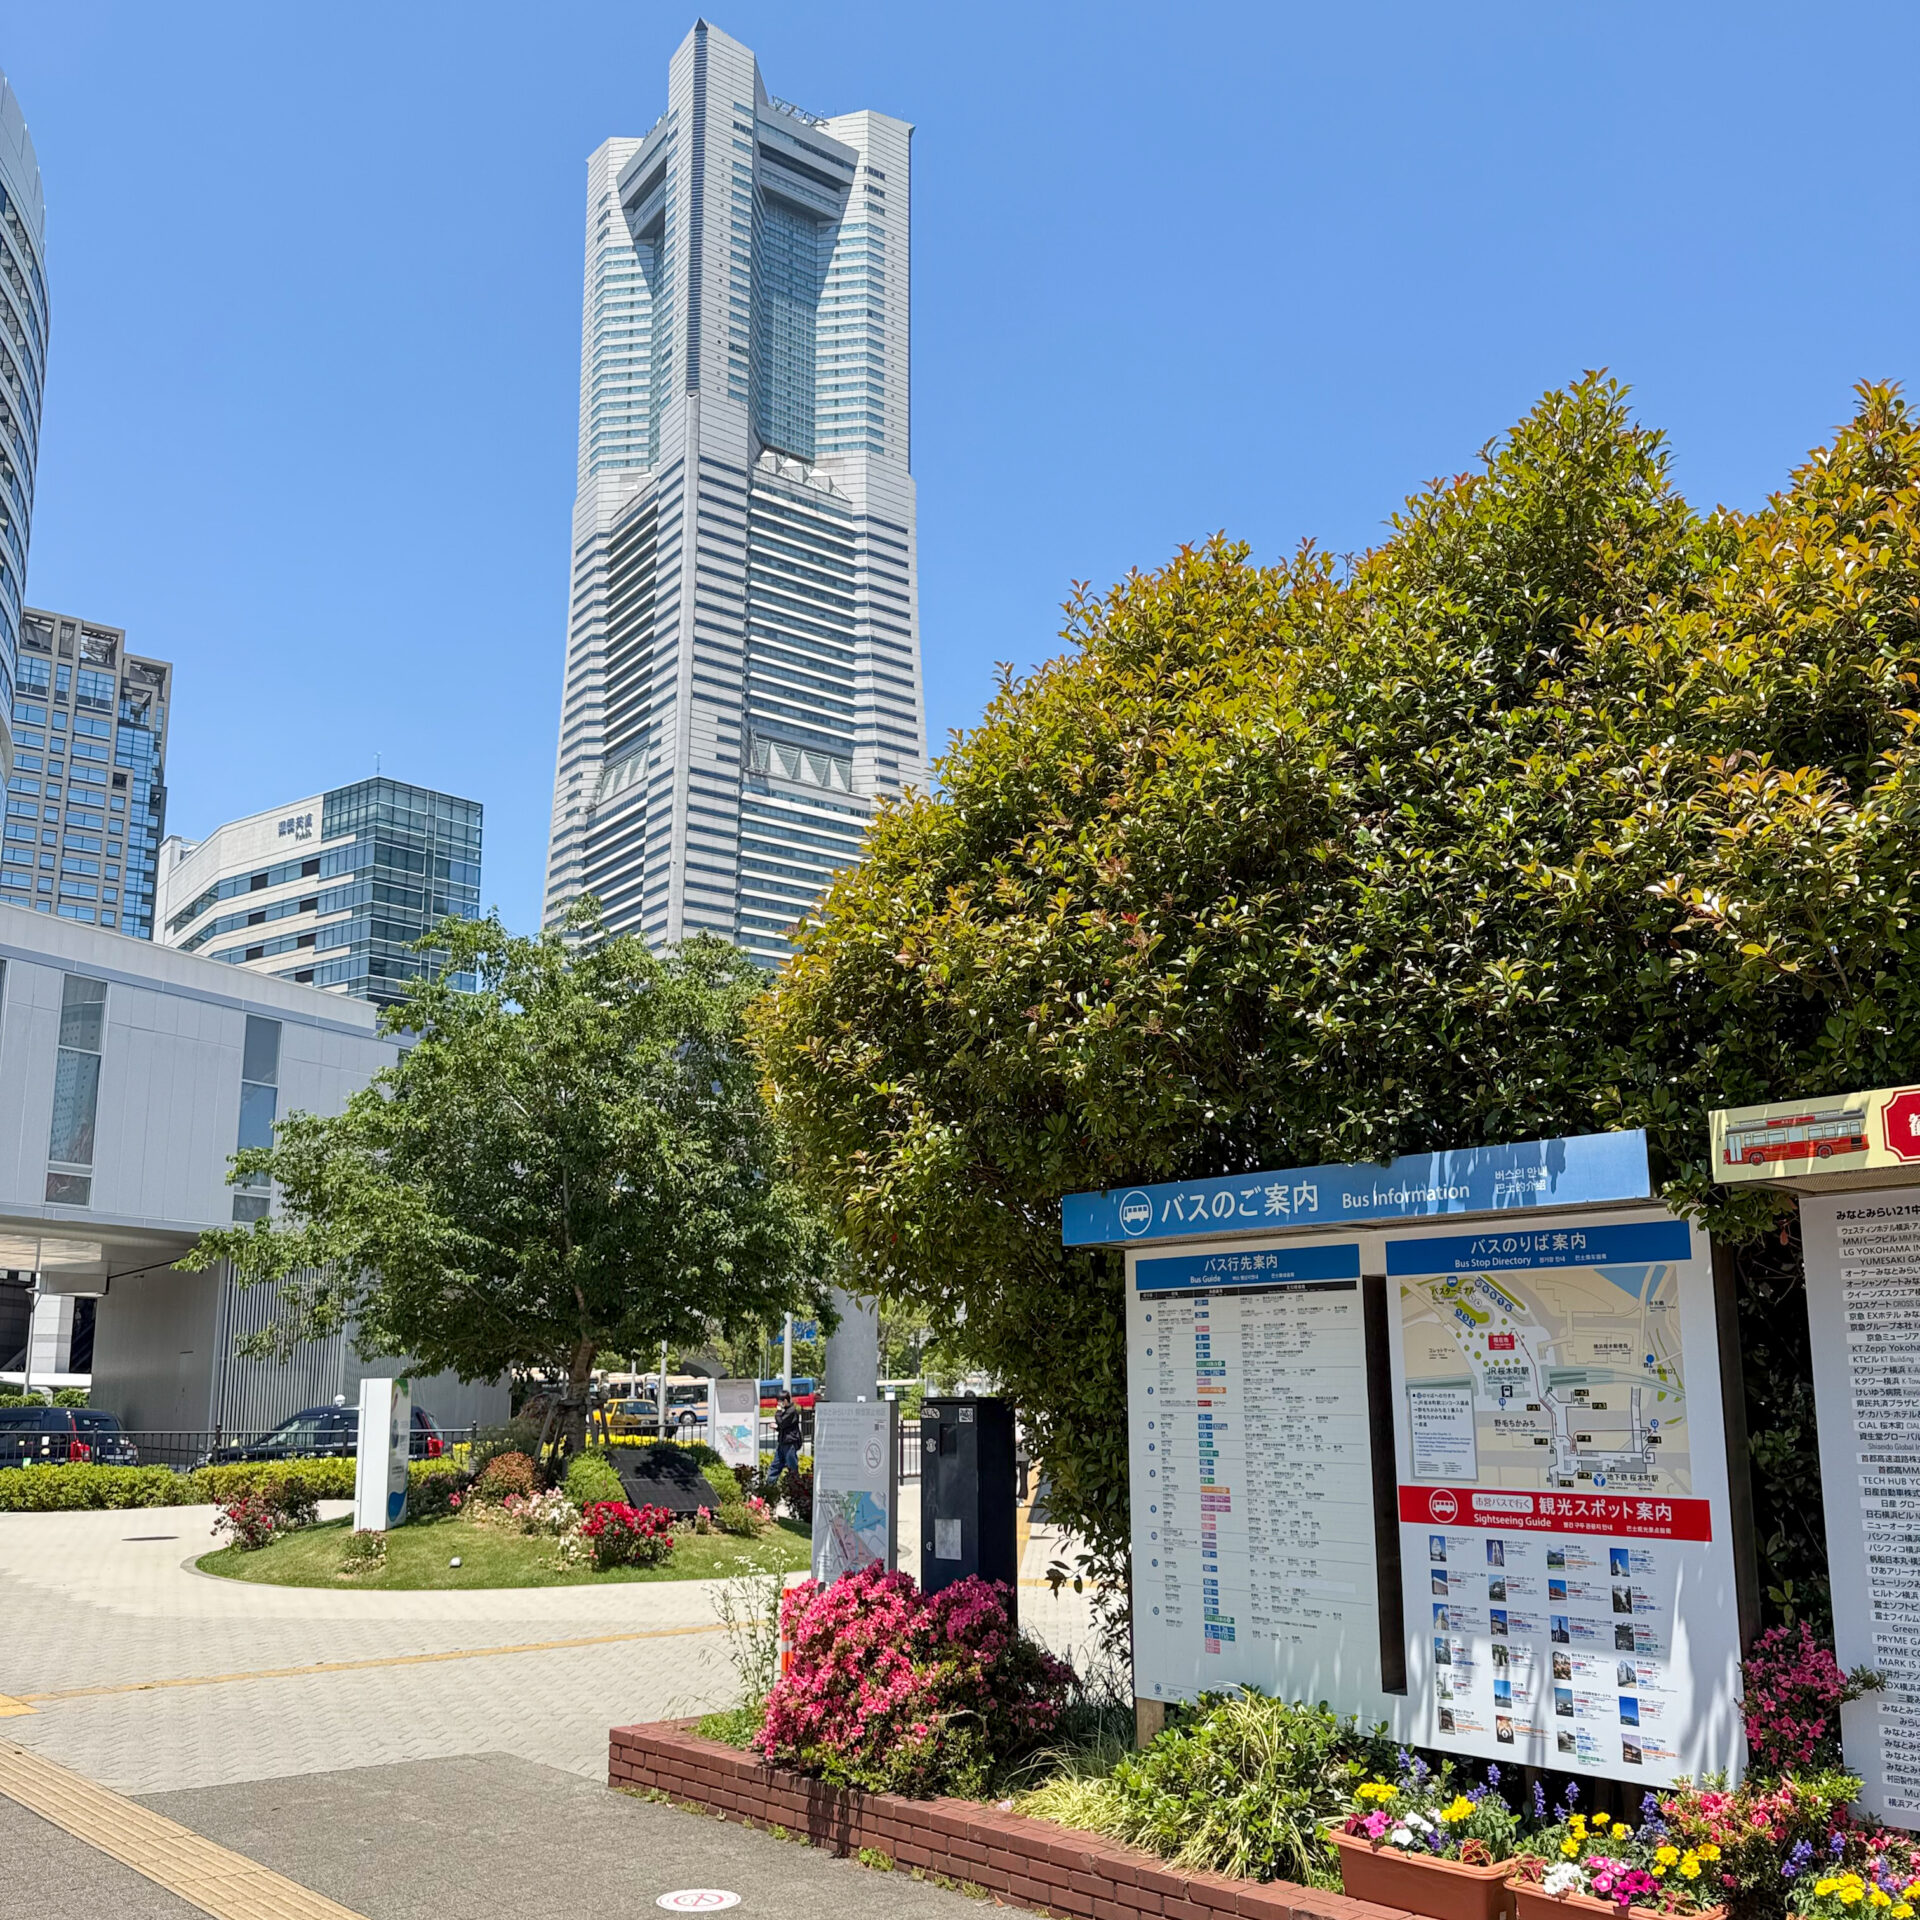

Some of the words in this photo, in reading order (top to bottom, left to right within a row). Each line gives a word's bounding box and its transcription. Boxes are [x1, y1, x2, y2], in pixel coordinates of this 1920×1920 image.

[1161, 1180, 1319, 1223] バスのご案内
[1342, 1192, 1370, 1209] Bus
[1373, 1184, 1470, 1207] Information
[1836, 1204, 1920, 1221] みなとみらい21中
[1841, 1222, 1920, 1236] ウェスティンホテル横浜・ア
[1471, 1232, 1587, 1254] バスのりば案内
[1843, 1247, 1855, 1256] LG
[1856, 1243, 1911, 1255] YOKOHAMA
[1204, 1254, 1278, 1272] バス行先案内
[1455, 1259, 1470, 1268] Bus
[1471, 1258, 1491, 1269] Stop
[1491, 1256, 1532, 1267] Directory
[1860, 1255, 1906, 1266] YUMESAKI
[1190, 1276, 1201, 1284] Bus
[1202, 1275, 1221, 1283] Guide
[1849, 1312, 1865, 1321] 京急
[1850, 1321, 1913, 1332] 京急グループ本社
[1866, 1332, 1919, 1342] 京急ミュージア
[1852, 1344, 1863, 1353] KT
[1865, 1345, 1887, 1354] Zepp
[1853, 1355, 1879, 1364] KTビル
[1486, 1366, 1497, 1375] JR
[1497, 1366, 1530, 1376] 桜木町駅
[1854, 1366, 1906, 1375] Kアリーナ横浜
[1855, 1377, 1900, 1386] Kタワー横浜
[1856, 1388, 1902, 1397] けいゆう病院
[1494, 1419, 1536, 1427] 野毛ちかみち
[1880, 1421, 1904, 1430] 桜木町
[1863, 1476, 1885, 1485] TECH
[1888, 1477, 1907, 1485] HUB
[1475, 1497, 1530, 1510] 市営バスで行く
[1538, 1496, 1673, 1521] 観光スポット案内
[1881, 1499, 1897, 1508] 日産
[1473, 1513, 1524, 1528] Sightseeing
[1525, 1516, 1552, 1527] Guide
[1866, 1510, 1914, 1520] 日石横浜ビル
[1867, 1521, 1920, 1531] ニューオータニ
[1870, 1555, 1920, 1566] 帆船日本丸・横
[1873, 1589, 1919, 1600] ヒルトン横浜
[1874, 1600, 1919, 1611] 富士ソフトビ
[1891, 1624, 1919, 1635] Green
[1876, 1634, 1908, 1645] PRYME
[1877, 1645, 1909, 1657] PRYME
[1878, 1657, 1907, 1668] MARK
[1908, 1660, 1917, 1669] IS
[1886, 1762, 1920, 1775] みなとみ
